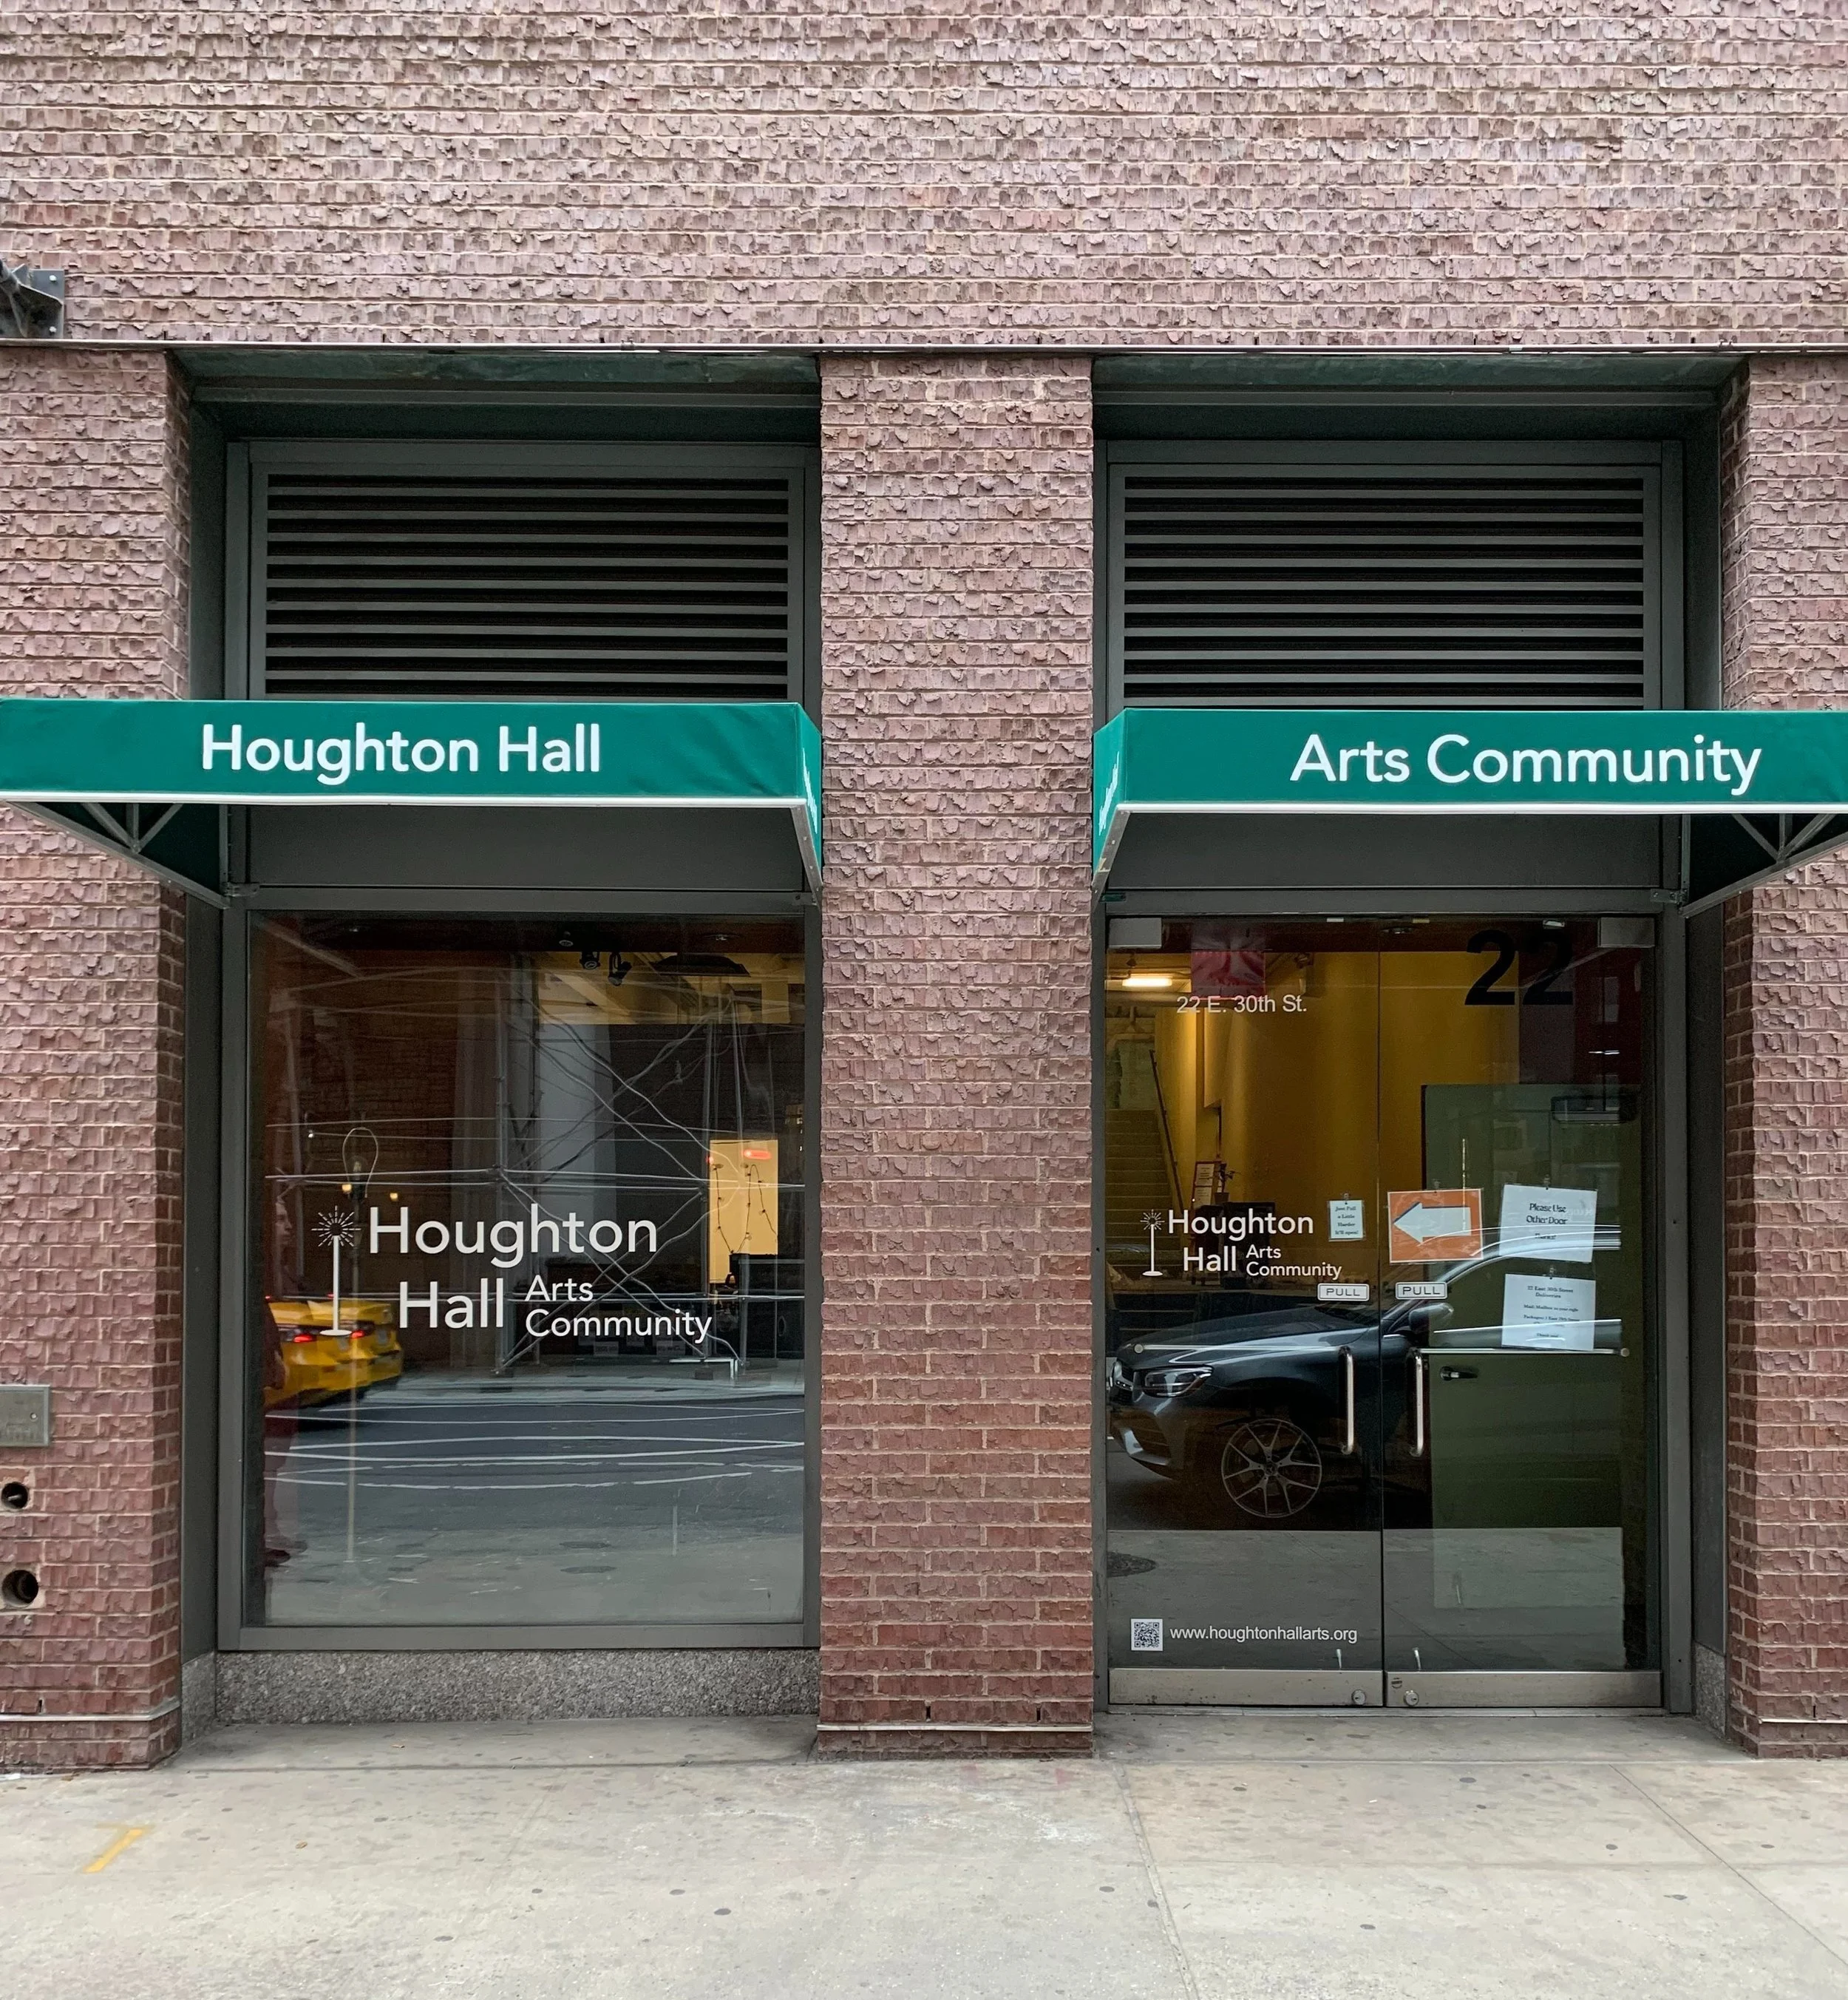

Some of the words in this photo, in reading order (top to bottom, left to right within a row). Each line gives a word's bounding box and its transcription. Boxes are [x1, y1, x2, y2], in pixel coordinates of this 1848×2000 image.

[203, 722, 478, 785] Houghton
[500, 724, 600, 773] Hall
[1289, 734, 1410, 782] Arts
[1427, 734, 1762, 796] Community
[1464, 929, 1574, 1006] 22
[1177, 996, 1200, 1013] 22
[1207, 996, 1226, 1013] E.
[1233, 994, 1276, 1013] 30th
[1282, 994, 1307, 1013] St.
[1526, 1215, 1549, 1224] Other
[1549, 1216, 1568, 1224] Door
[1529, 1203, 1552, 1212] Please
[1552, 1204, 1567, 1213] Use
[370, 1203, 657, 1268] Houghton
[1168, 1207, 1314, 1241] Houghton
[1183, 1246, 1236, 1272] Hall
[1246, 1244, 1282, 1258] Arts
[1246, 1261, 1342, 1281] Community
[525, 1275, 594, 1302] Arts
[1325, 1288, 1361, 1296] PULL
[1402, 1286, 1441, 1295] PULL
[399, 1278, 503, 1329] Hall
[525, 1308, 712, 1343] Community
[1169, 1625, 1358, 1644] www.houghtonhallarts.org
